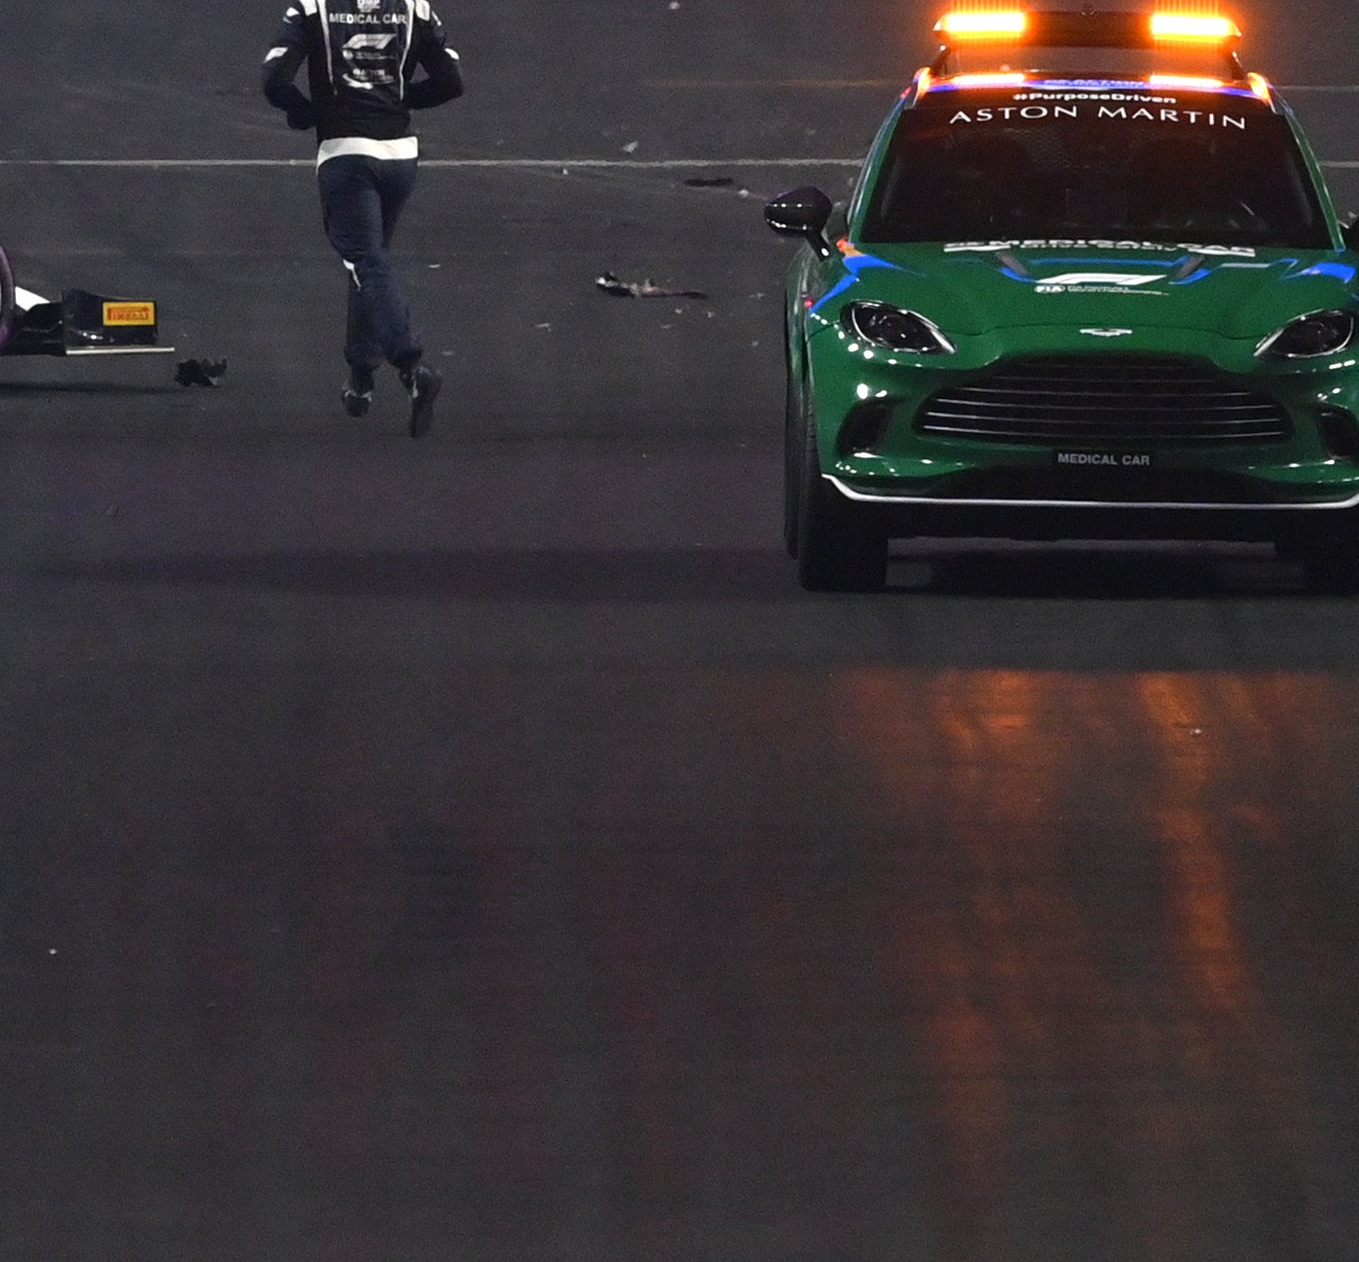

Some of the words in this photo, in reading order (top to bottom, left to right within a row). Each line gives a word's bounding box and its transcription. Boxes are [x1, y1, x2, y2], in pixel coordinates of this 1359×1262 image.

[329, 13, 380, 24] MEDICAL
[382, 13, 407, 24] CAR
[1013, 93, 1177, 104] #PurposeDriven
[949, 106, 1077, 124] ASTON
[1098, 106, 1246, 129] MARTIN
[1057, 452, 1118, 466] MEDICAL
[1121, 454, 1151, 466] CAR
